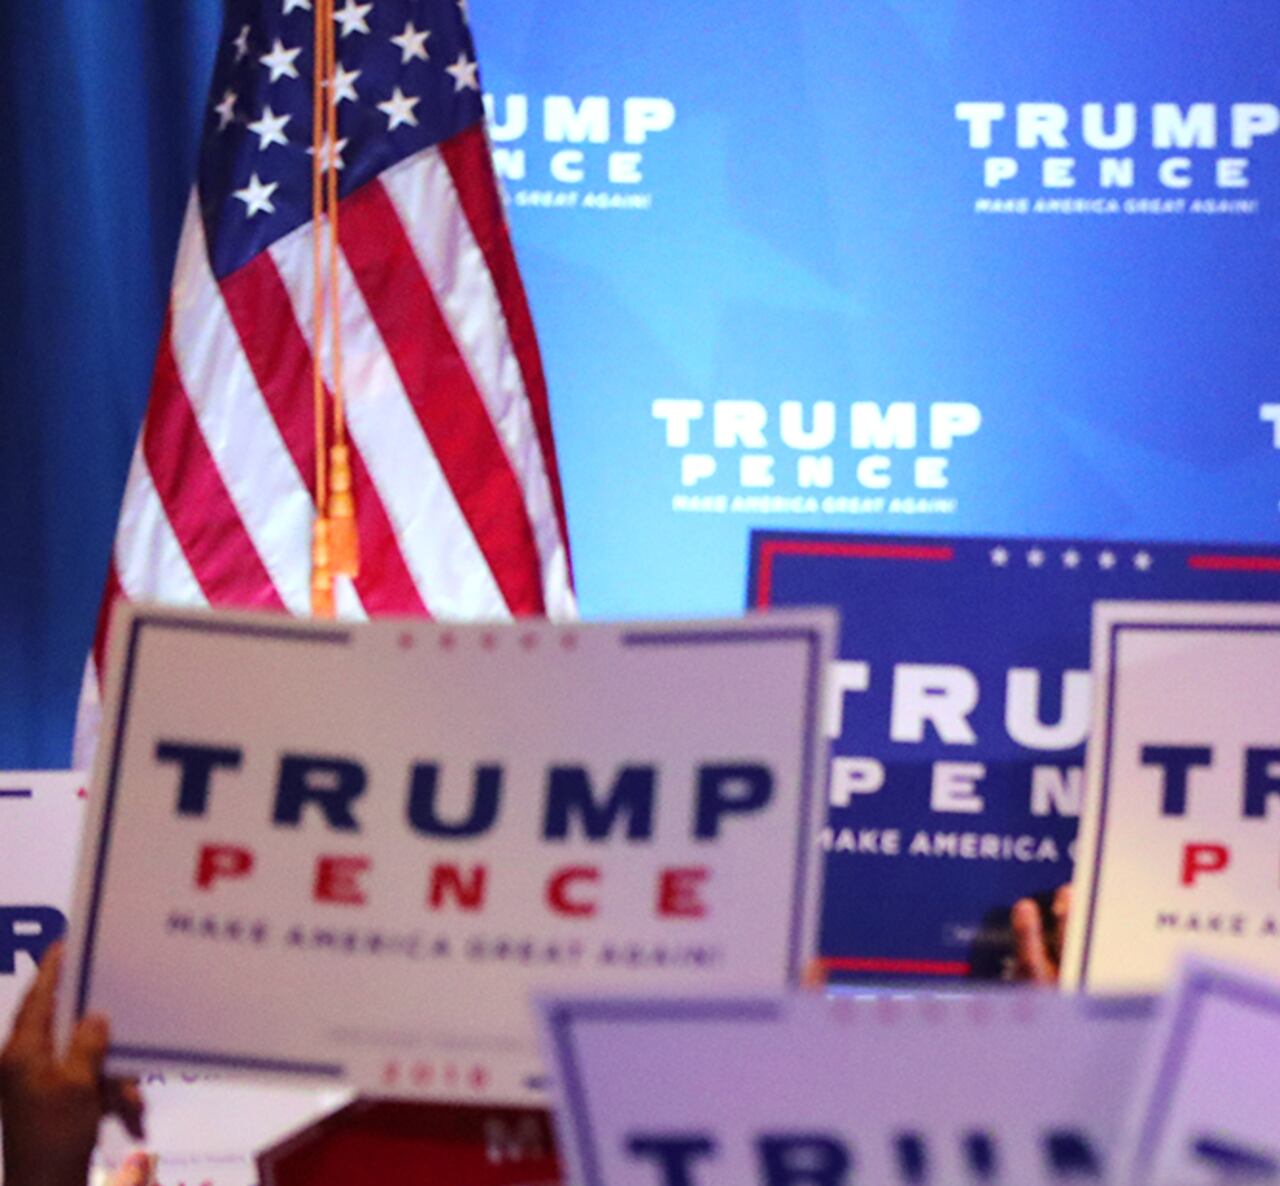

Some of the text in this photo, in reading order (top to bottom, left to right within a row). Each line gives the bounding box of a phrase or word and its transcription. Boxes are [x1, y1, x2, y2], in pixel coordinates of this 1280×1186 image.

[984, 157, 1249, 188] PENCE
[651, 399, 982, 449] TRUMP
[681, 454, 949, 488] PENCE
[154, 737, 774, 842] TRUMP
[909, 829, 1058, 862] AMERICA
[194, 843, 710, 920] PENCE
[1154, 911, 1248, 938] MAKE
